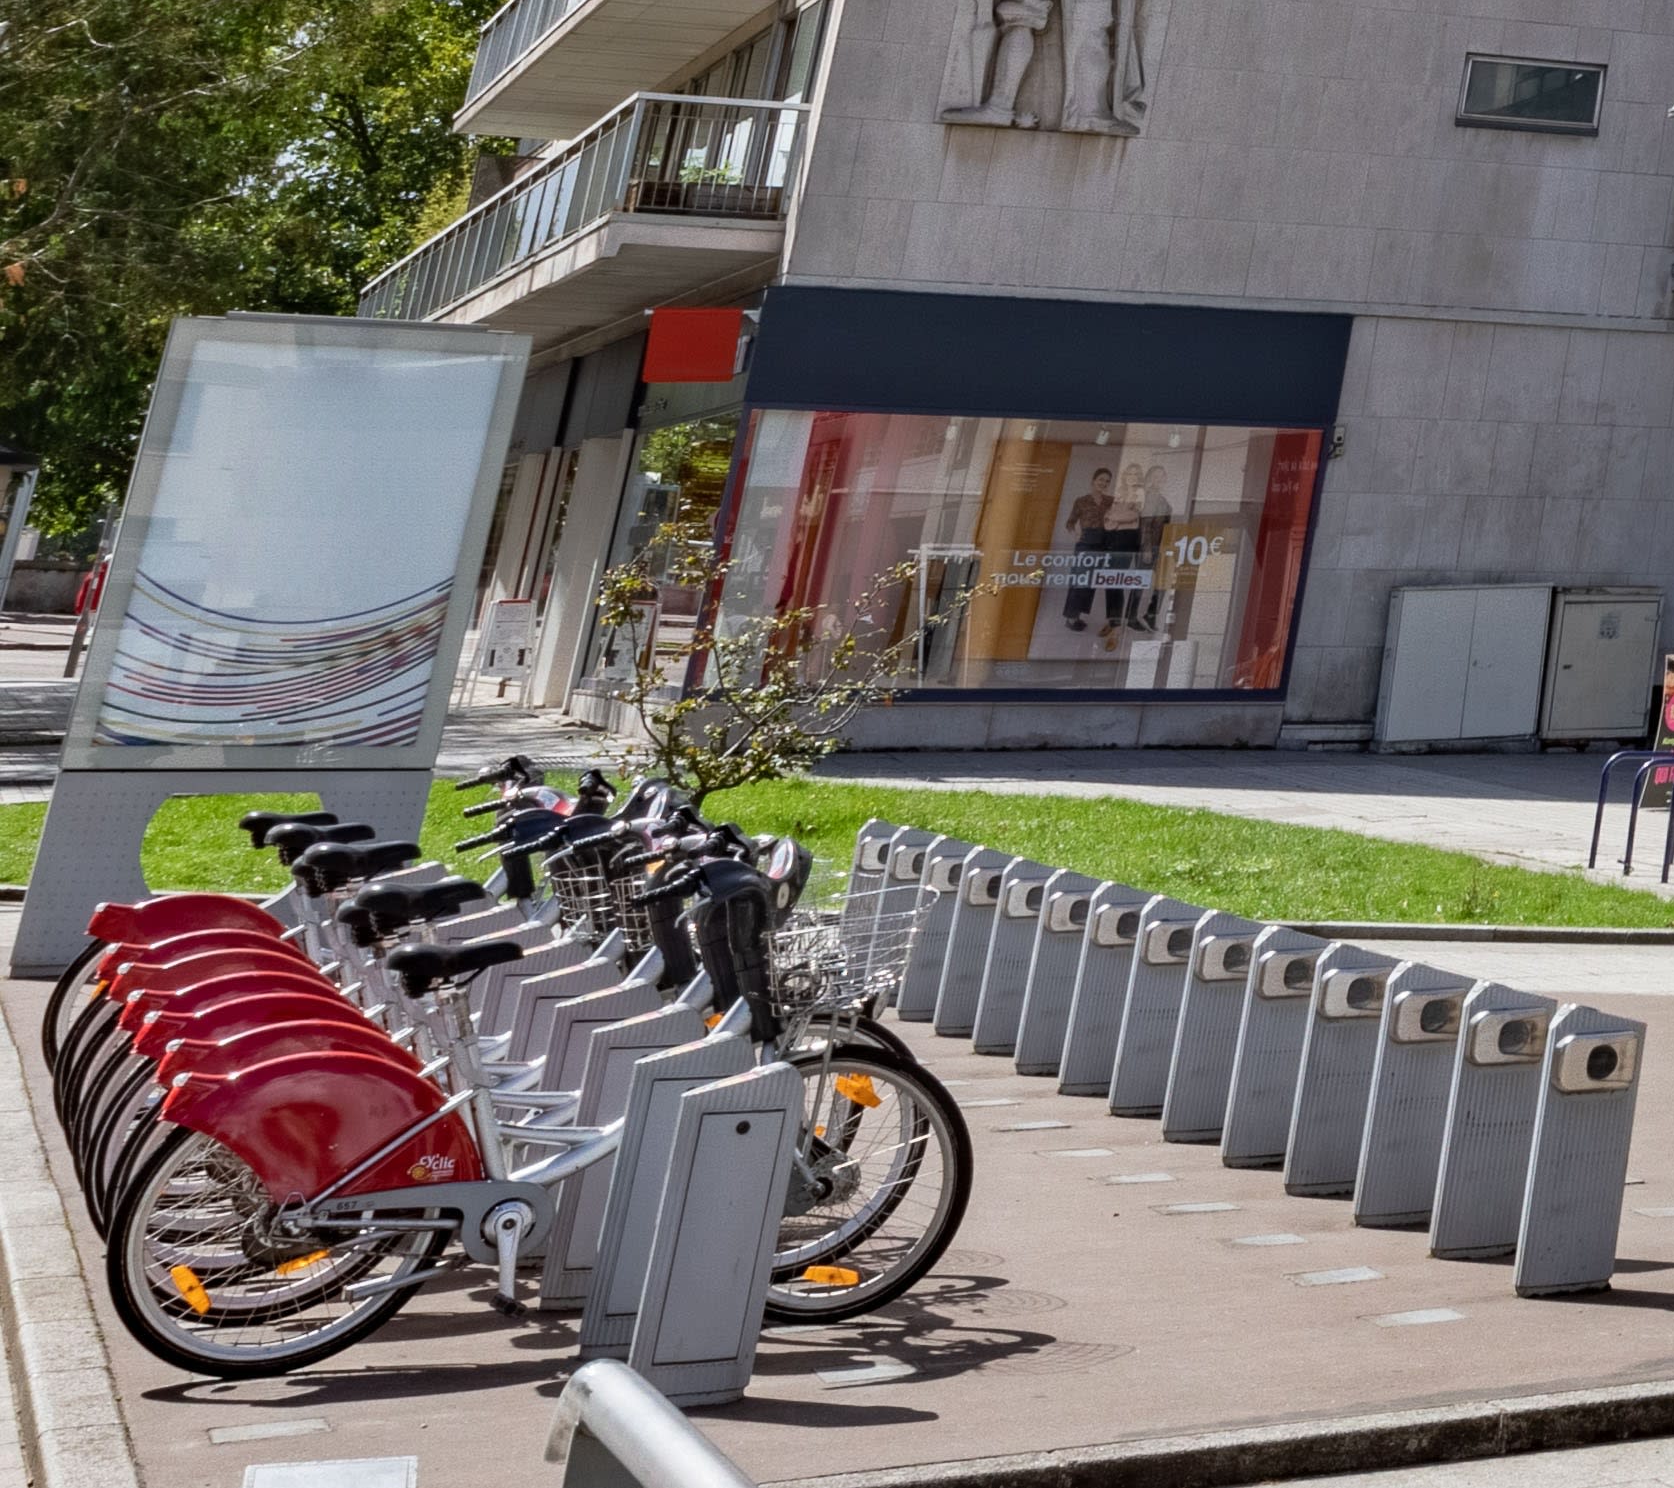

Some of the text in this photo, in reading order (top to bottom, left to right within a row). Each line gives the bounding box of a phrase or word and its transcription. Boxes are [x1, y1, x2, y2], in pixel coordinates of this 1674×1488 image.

[1012, 550, 1112, 568] Le confort
[1045, 572, 1089, 587] rend
